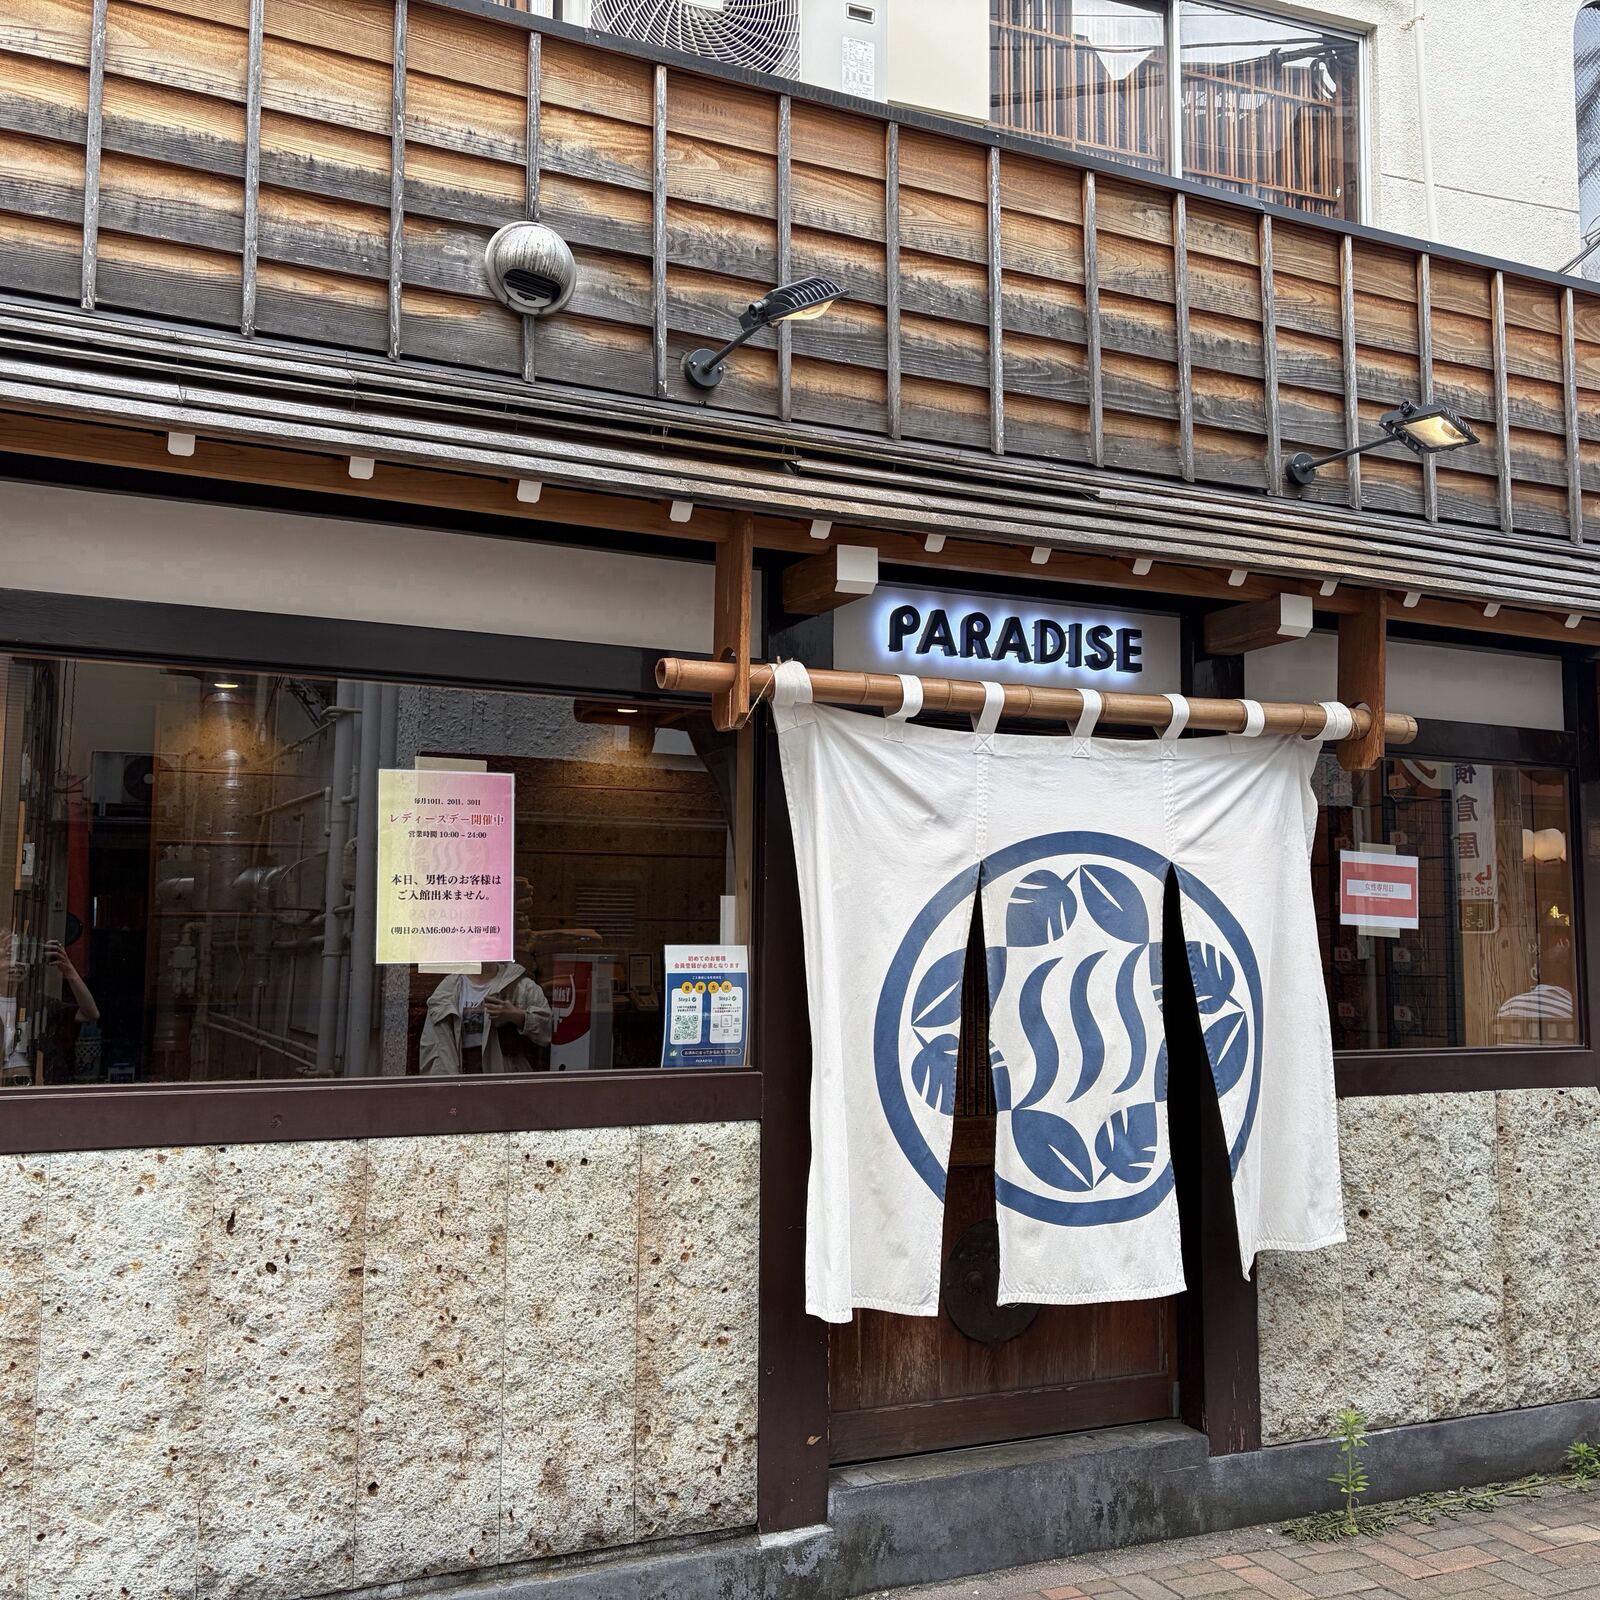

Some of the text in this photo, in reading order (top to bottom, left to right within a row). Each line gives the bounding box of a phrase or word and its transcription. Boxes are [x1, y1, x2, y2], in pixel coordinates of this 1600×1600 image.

[888, 604, 1143, 673] PARADISE
[390, 813, 504, 826] レディースデー開催中
[408, 831, 438, 839] 営業時間
[467, 831, 487, 839] 24:00
[391, 874, 501, 886] 本日、男性のお客様は
[398, 891, 491, 901] ご入館出来ません。
